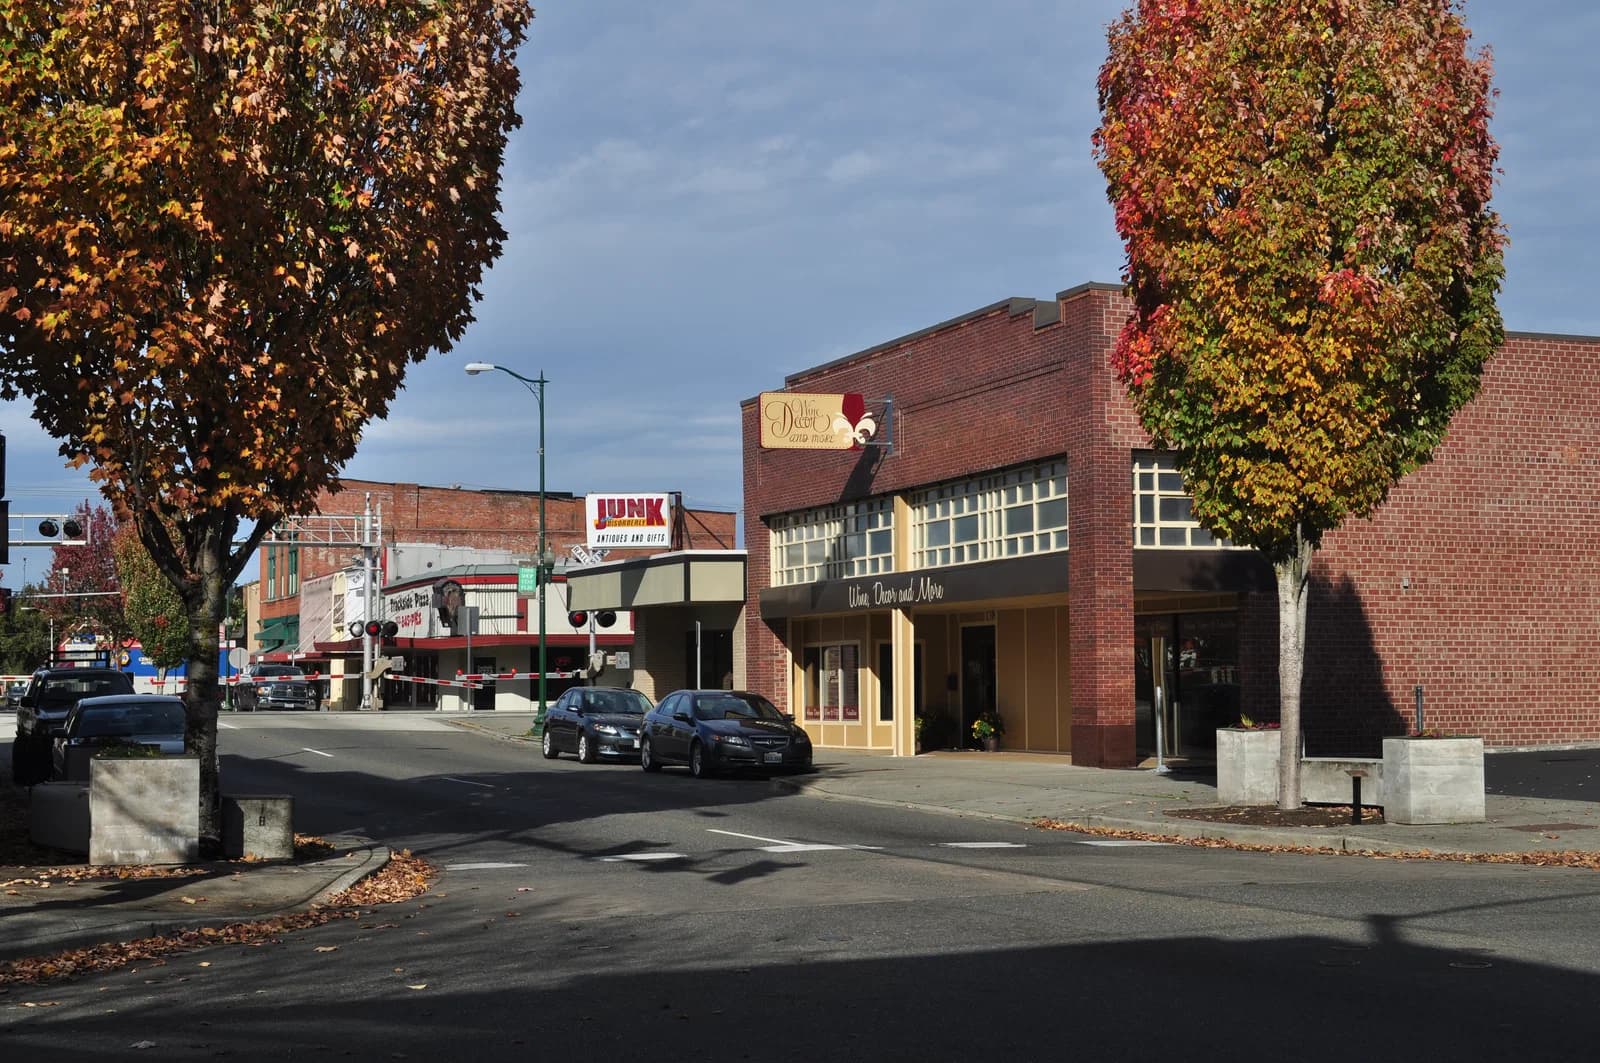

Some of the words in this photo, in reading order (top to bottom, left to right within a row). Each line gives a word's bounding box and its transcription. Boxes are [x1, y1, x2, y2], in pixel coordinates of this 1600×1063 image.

[765, 401, 831, 438] Decor
[791, 398, 823, 417] Wine
[595, 498, 665, 530] JUNK
[597, 534, 628, 543] ANTIQUES
[631, 533, 644, 542] AND
[647, 533, 665, 542] GIFTS
[414, 592, 429, 608] Pizza
[873, 581, 898, 605] Decor
[898, 577, 914, 603] and
[915, 576, 944, 603] More
